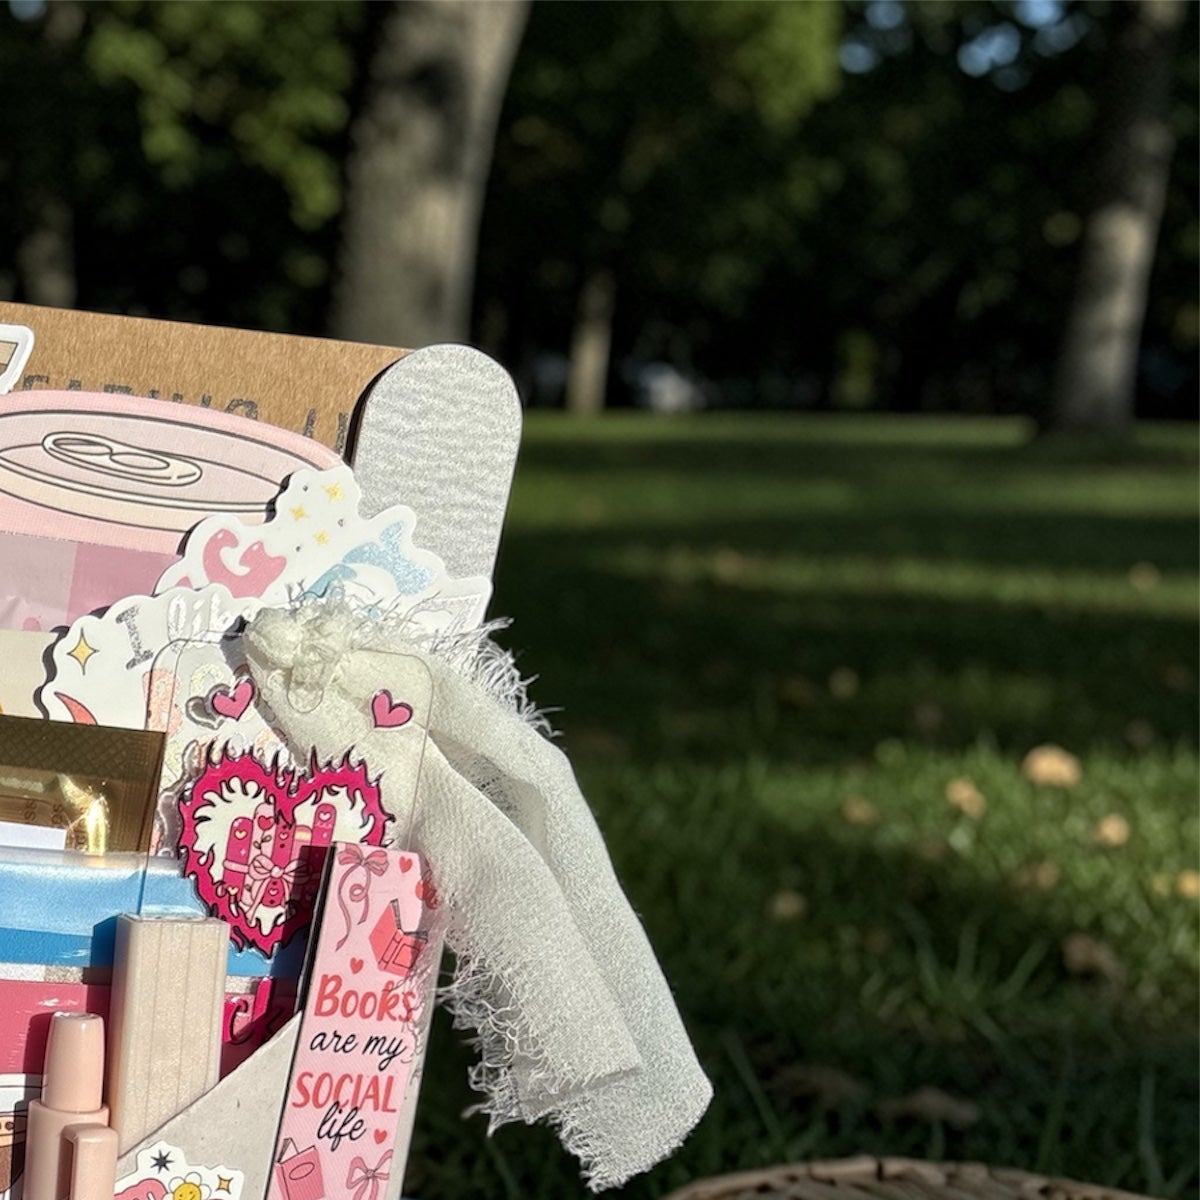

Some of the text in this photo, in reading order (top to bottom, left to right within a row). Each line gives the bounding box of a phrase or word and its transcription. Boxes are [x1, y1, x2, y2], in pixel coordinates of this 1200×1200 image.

[314, 973, 416, 1023] Books
[309, 1030, 408, 1071] are my
[291, 1071, 398, 1113] SOCIAL
[316, 1100, 368, 1152] life
